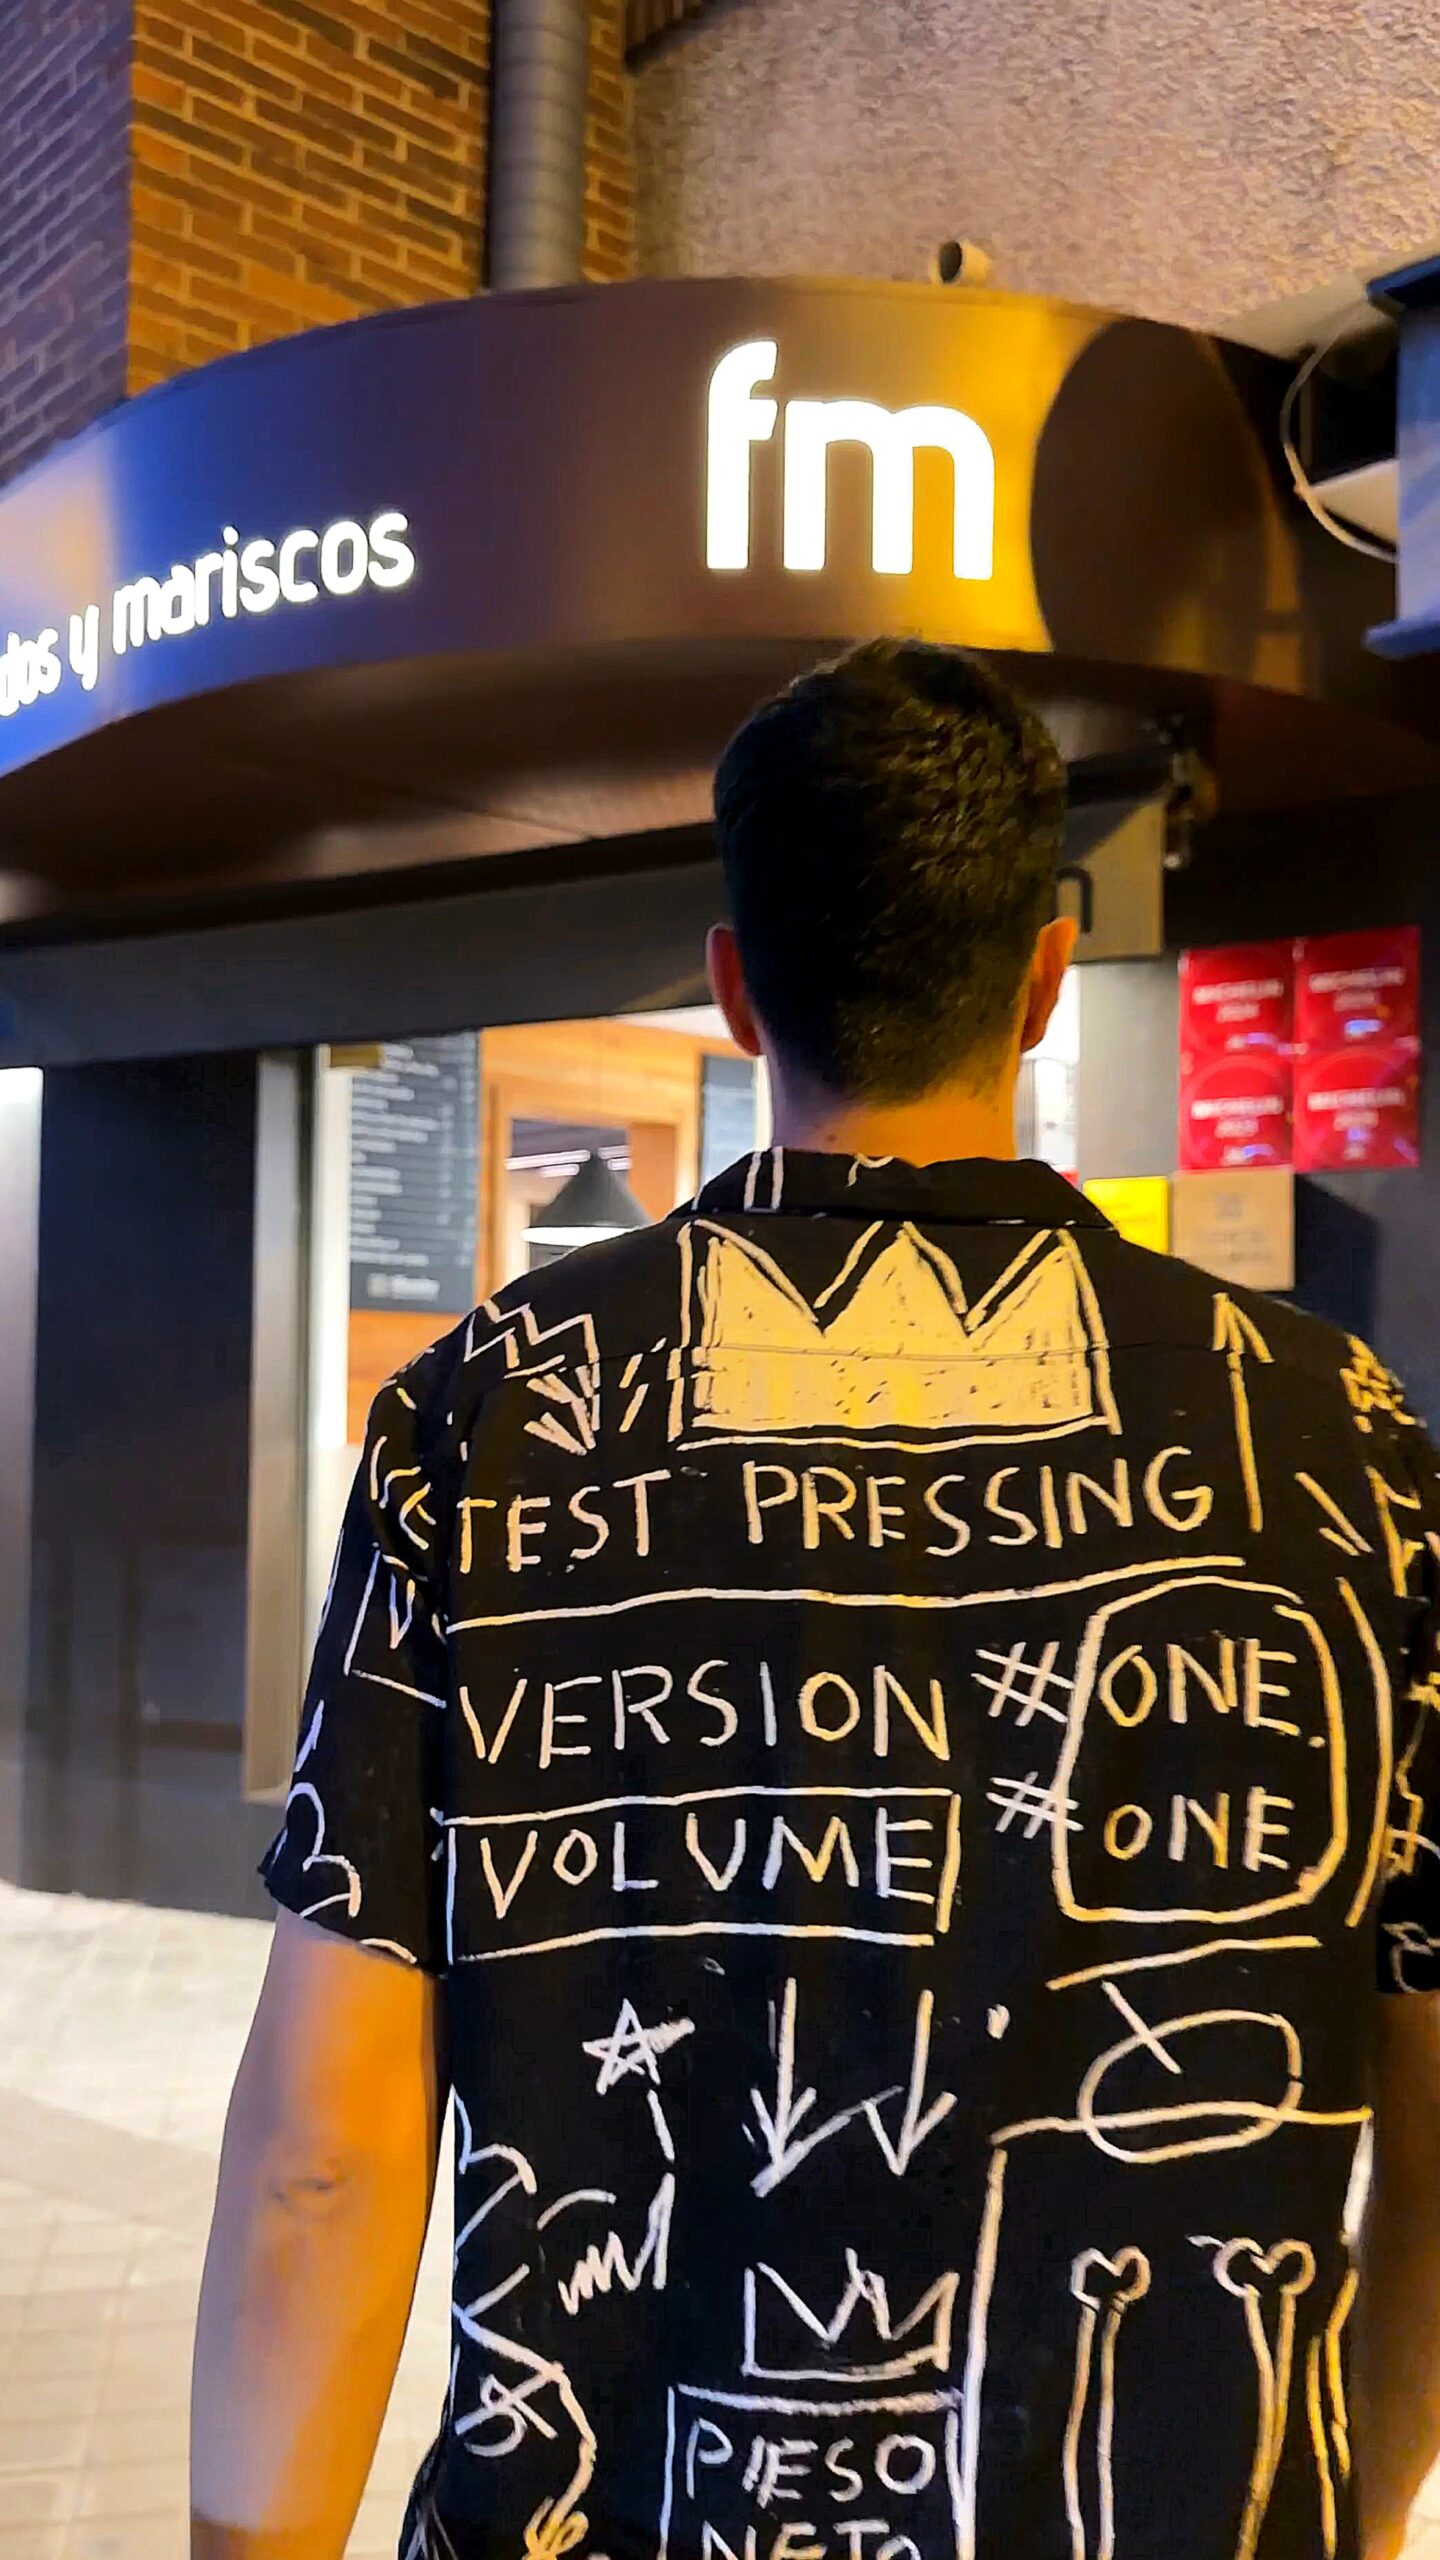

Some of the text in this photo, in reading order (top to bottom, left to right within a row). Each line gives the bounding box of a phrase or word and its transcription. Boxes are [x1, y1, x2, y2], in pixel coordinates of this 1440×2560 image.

[706, 339, 996, 581] fm
[68, 604, 100, 692] y
[112, 511, 416, 656] mariscos
[455, 1444, 1215, 1575] TEST PRESSING
[459, 1658, 952, 1771] VERSION
[479, 1806, 937, 1921] VOLUME
